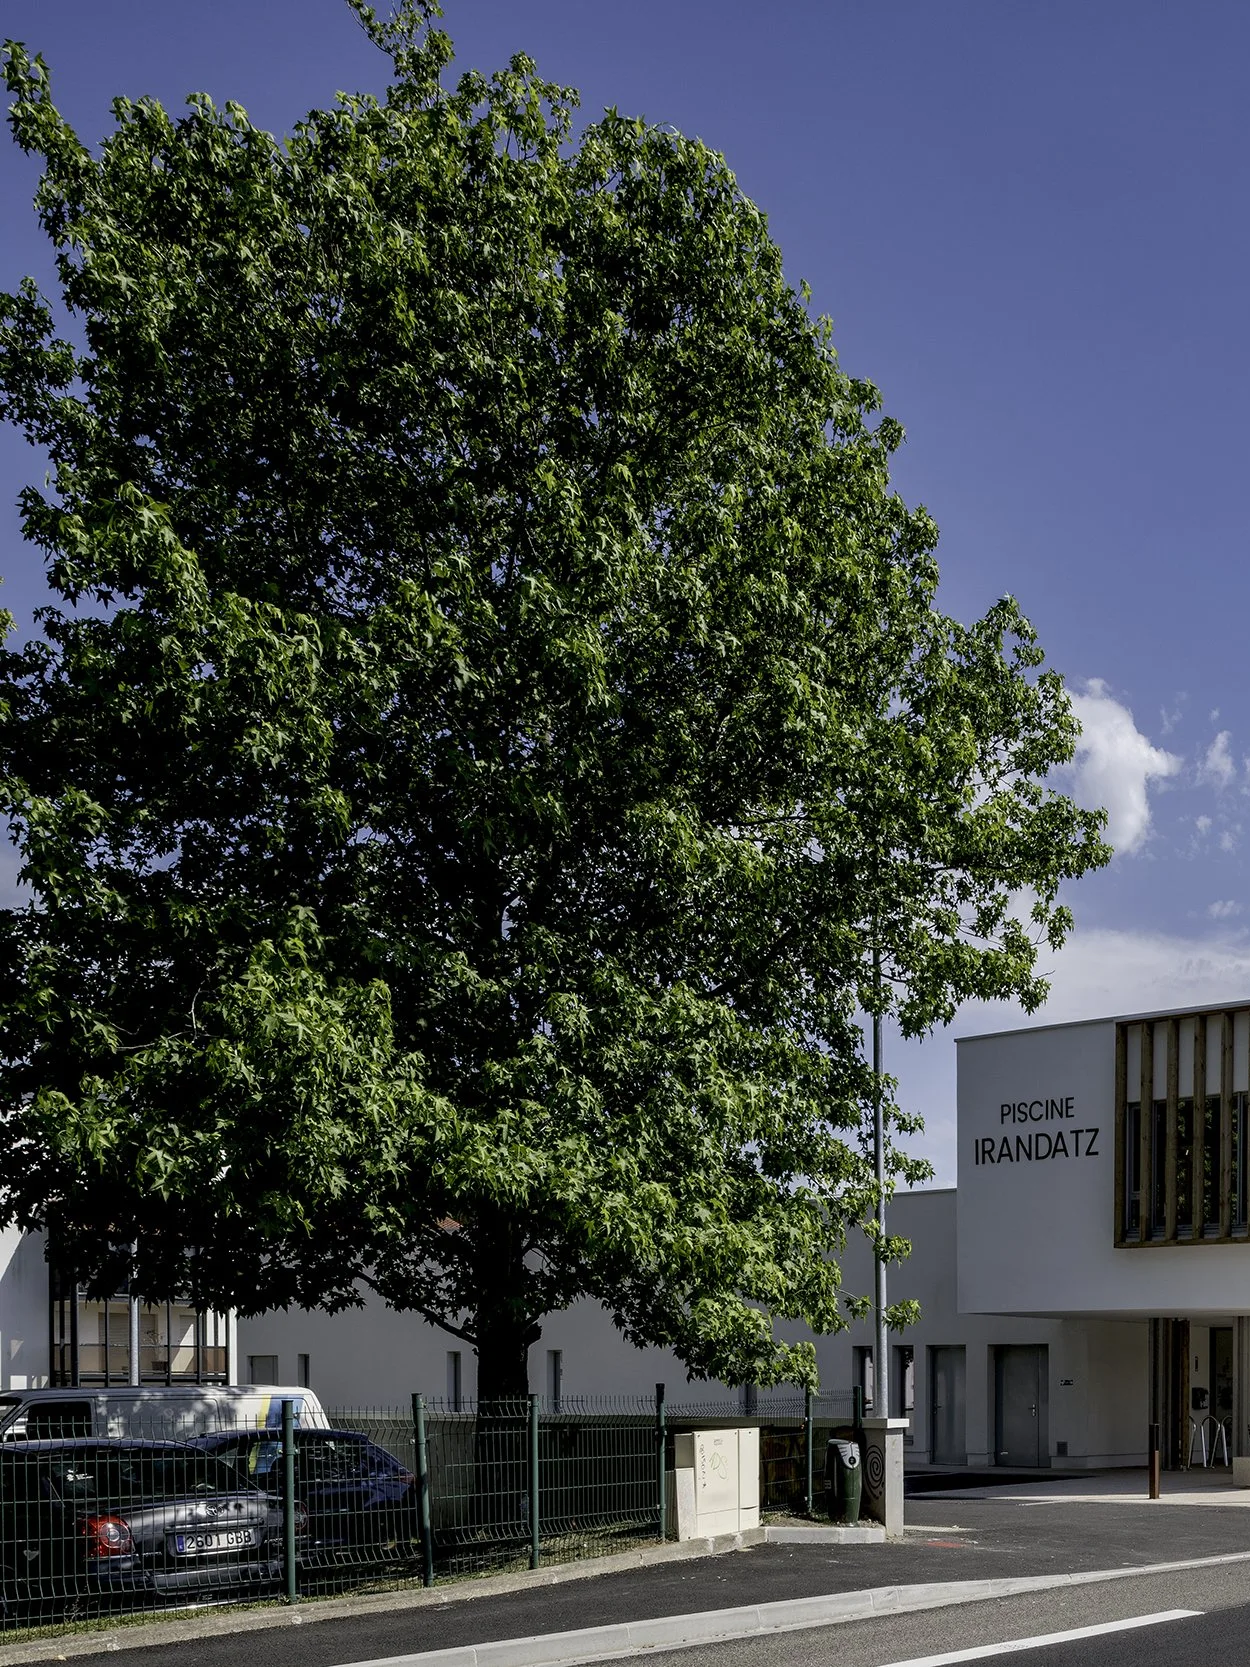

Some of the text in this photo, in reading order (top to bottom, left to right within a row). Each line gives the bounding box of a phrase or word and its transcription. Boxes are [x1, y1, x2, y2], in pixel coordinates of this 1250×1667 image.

[1000, 1096, 1075, 1125] PISCINE
[975, 1128, 1100, 1166] IRANDATZ
[186, 1530, 252, 1549] 2601 GBB
